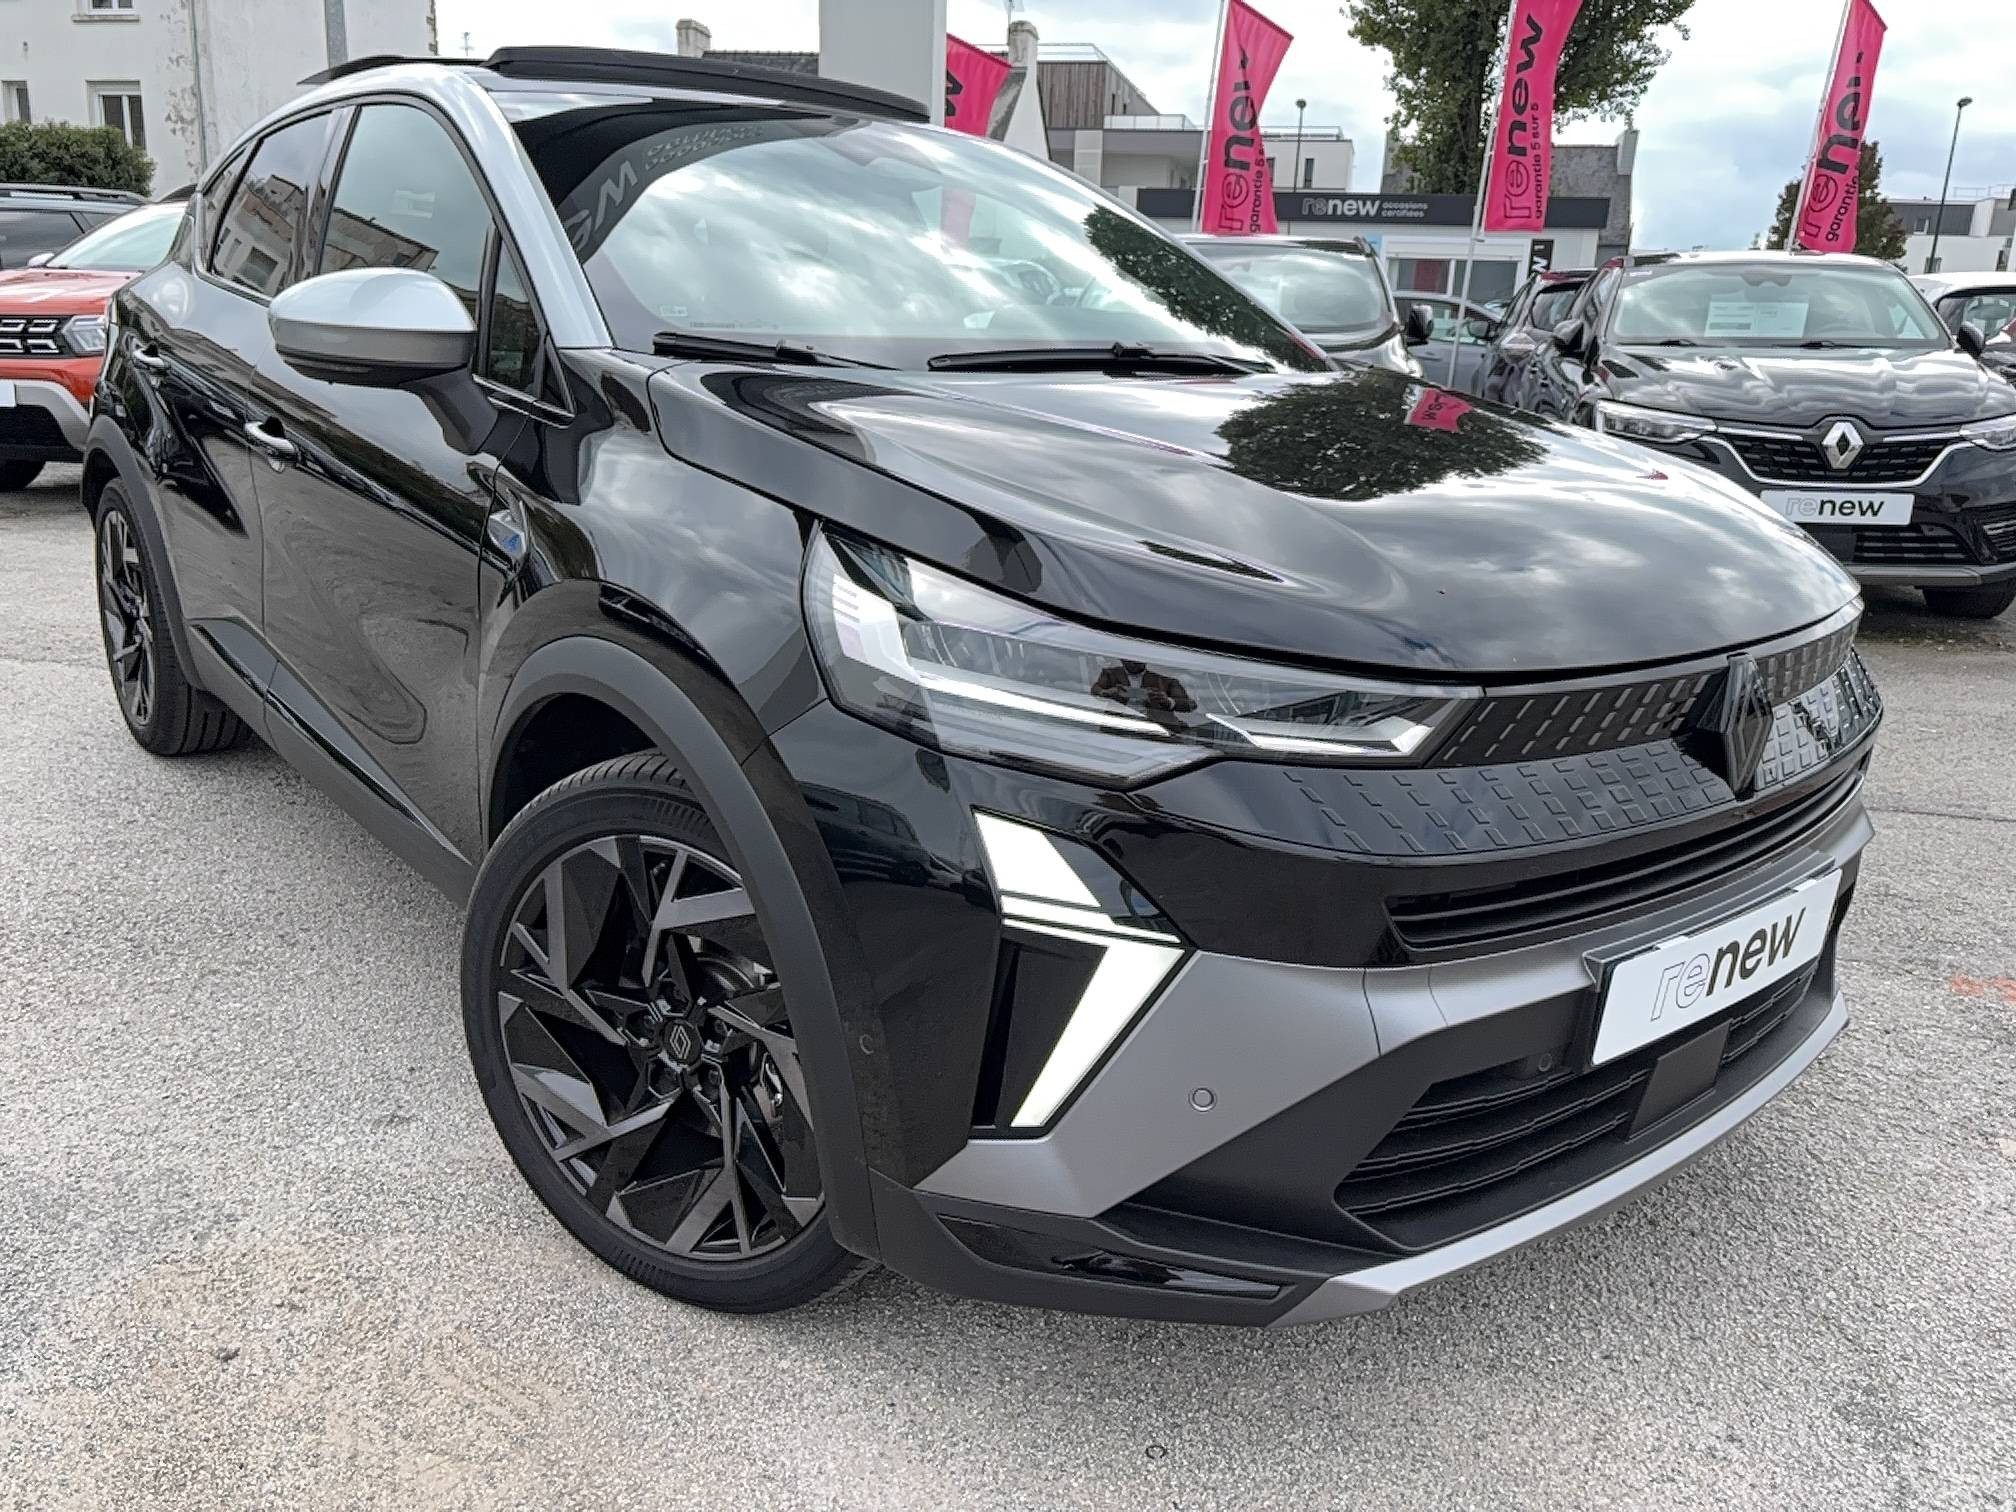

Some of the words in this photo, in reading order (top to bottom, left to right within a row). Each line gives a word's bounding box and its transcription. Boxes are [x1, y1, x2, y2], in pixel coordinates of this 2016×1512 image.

[1504, 14, 1543, 219] renew
[1531, 115, 1540, 138] sur
[1531, 143, 1541, 152] 5
[1249, 170, 1263, 233] garantie
[1302, 198, 1381, 217] renew
[1531, 155, 1543, 219] garantie
[1785, 497, 1884, 517] renew
[1650, 906, 1806, 1021] renew
